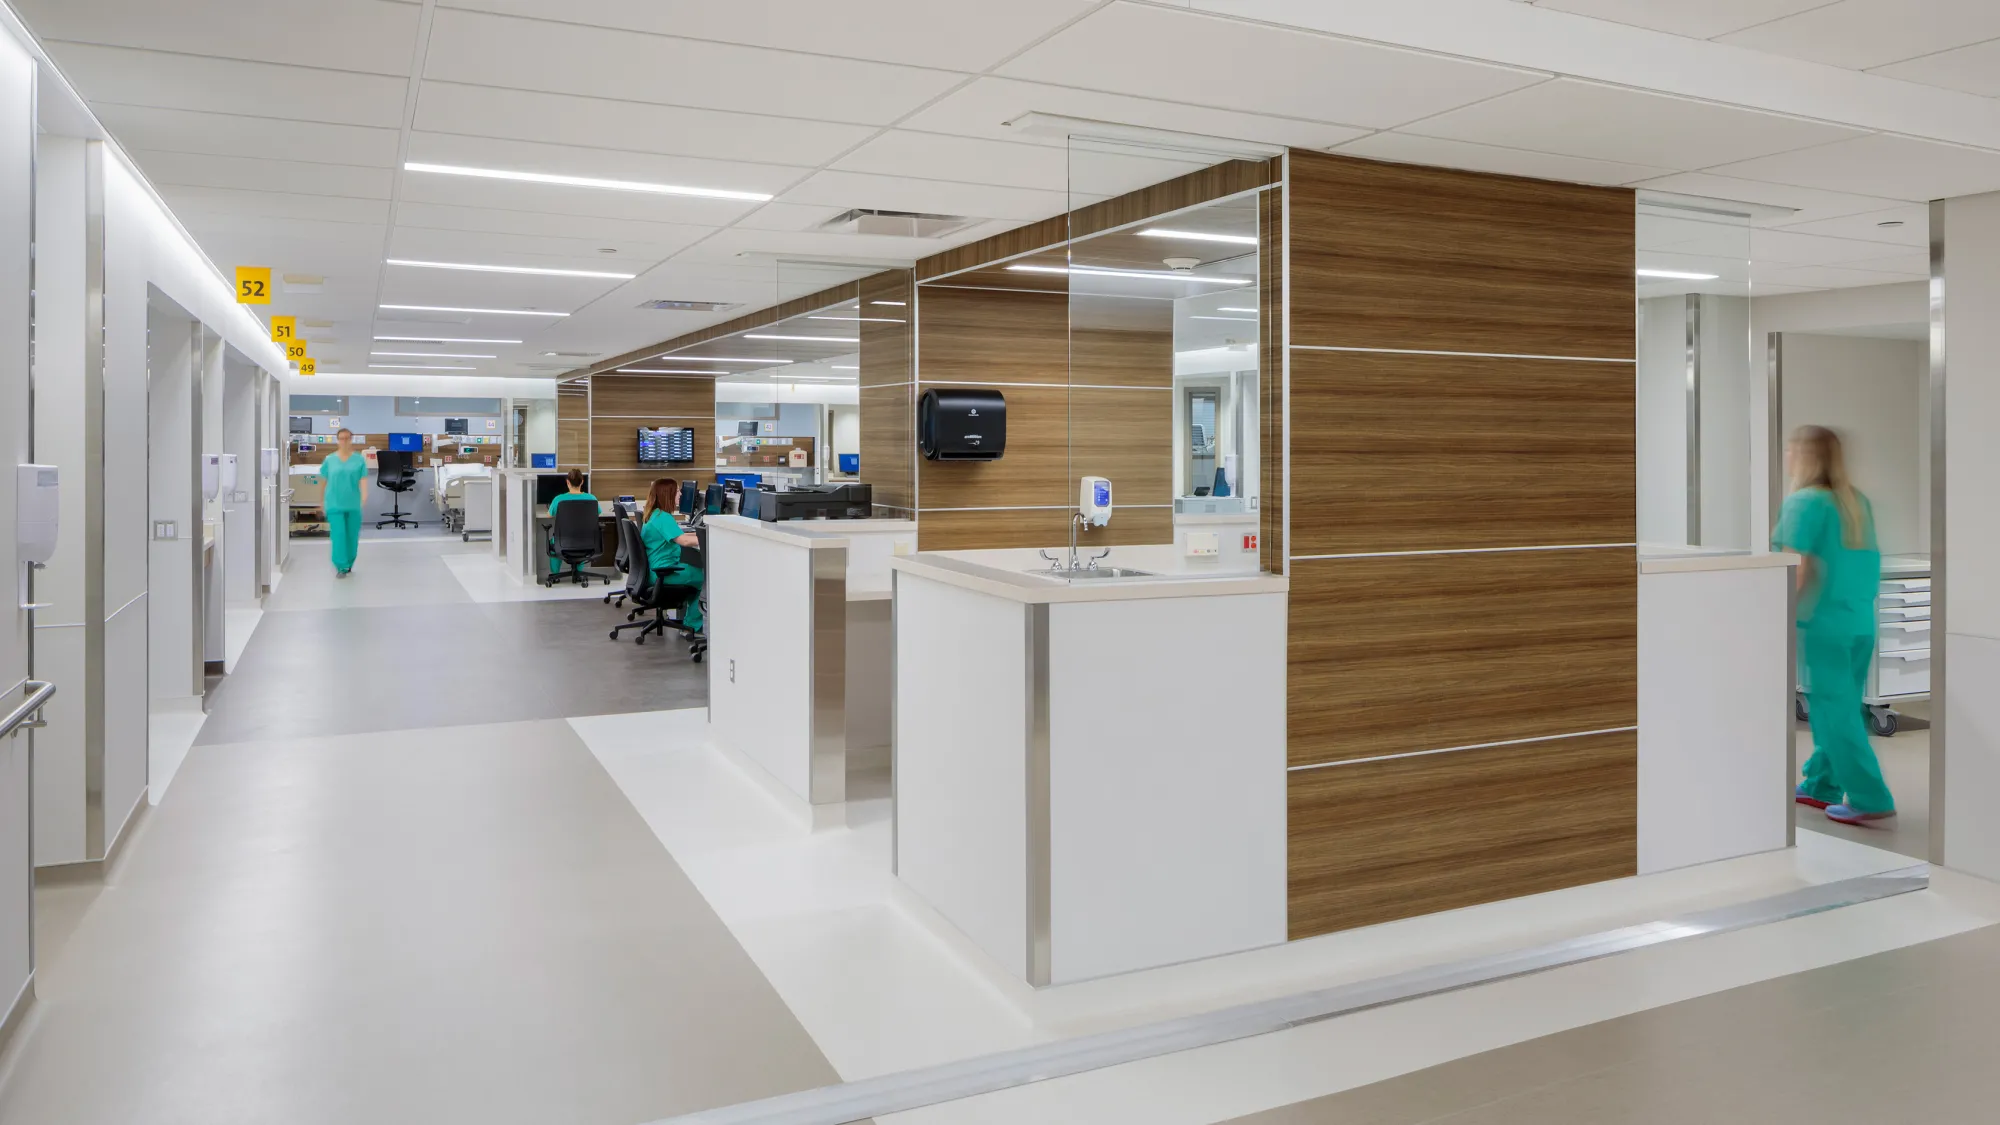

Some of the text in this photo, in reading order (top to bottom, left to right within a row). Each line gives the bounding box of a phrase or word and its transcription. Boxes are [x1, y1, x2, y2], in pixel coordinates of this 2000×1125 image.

[242, 280, 265, 297] 52
[276, 325, 290, 337] 51
[289, 347, 304, 357] 50
[301, 364, 314, 372] 49
